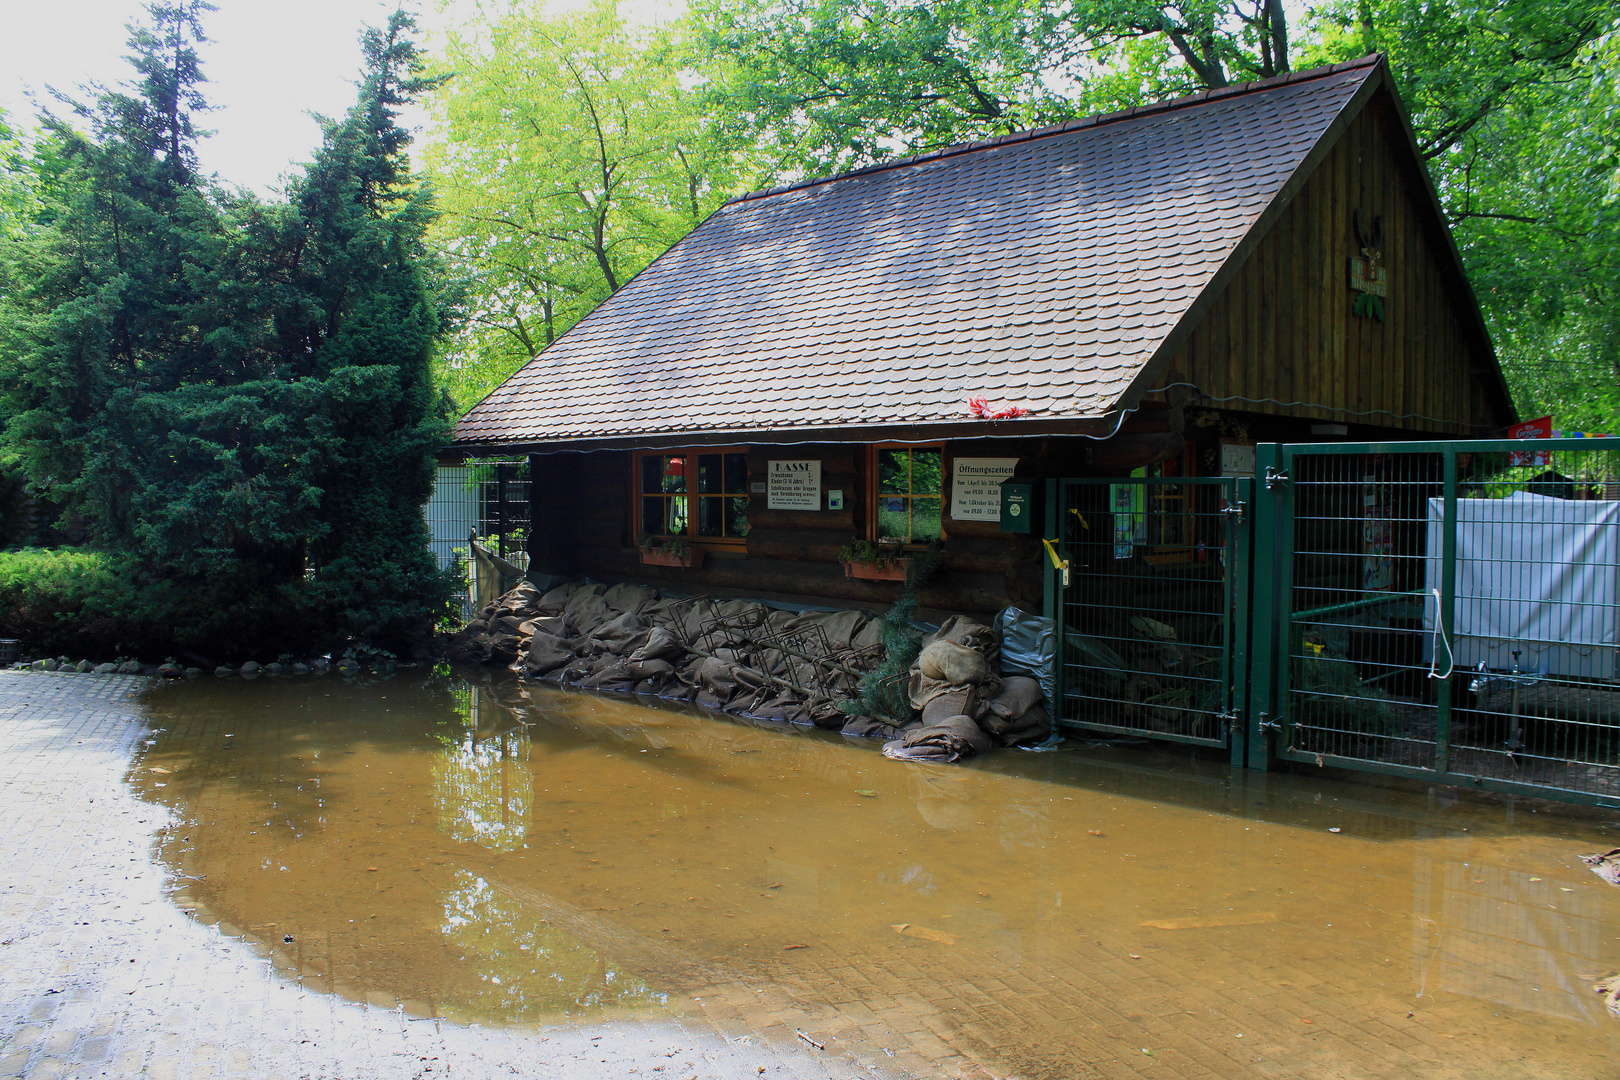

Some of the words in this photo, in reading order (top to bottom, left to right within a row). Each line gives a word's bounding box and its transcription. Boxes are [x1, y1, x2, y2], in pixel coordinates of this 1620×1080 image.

[1515, 428, 1544, 438] Cornetto
[775, 463, 812, 472] KASSE
[959, 463, 1013, 474] Öffnungszeiten
